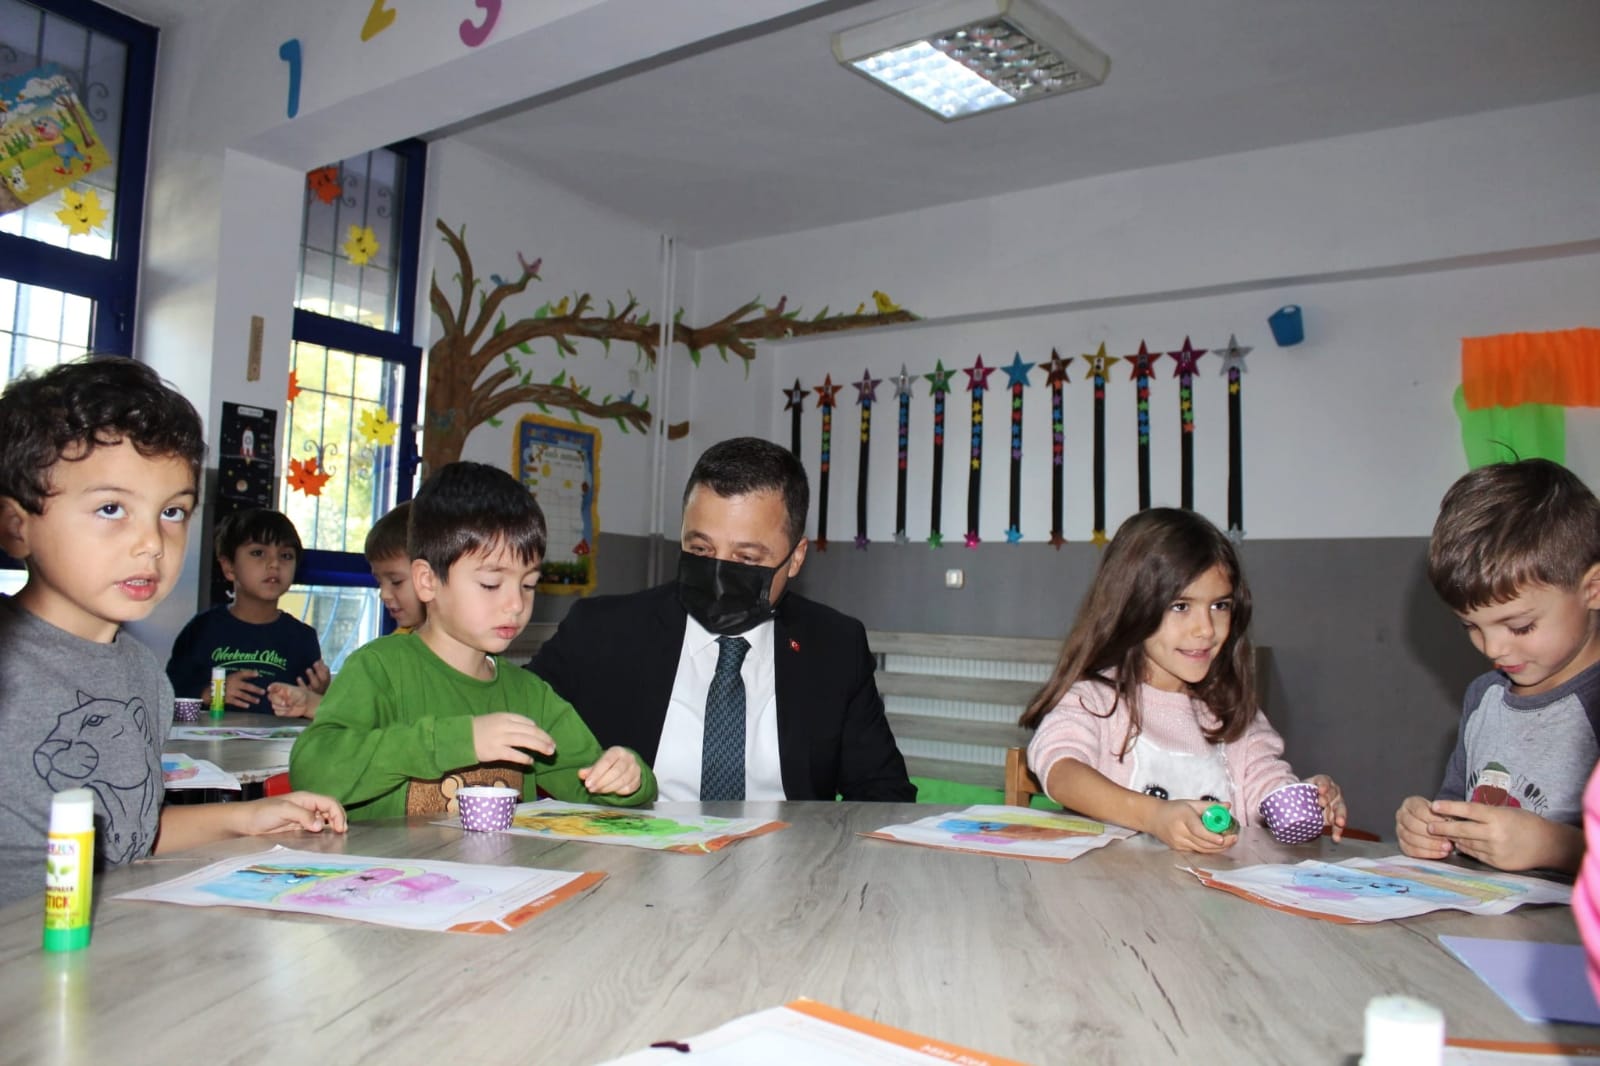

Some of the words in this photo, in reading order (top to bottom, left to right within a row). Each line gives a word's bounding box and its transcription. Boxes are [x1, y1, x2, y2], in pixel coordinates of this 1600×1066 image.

[279, 38, 302, 119] 1
[211, 646, 260, 662] Weekend
[260, 649, 288, 667] Vibes
